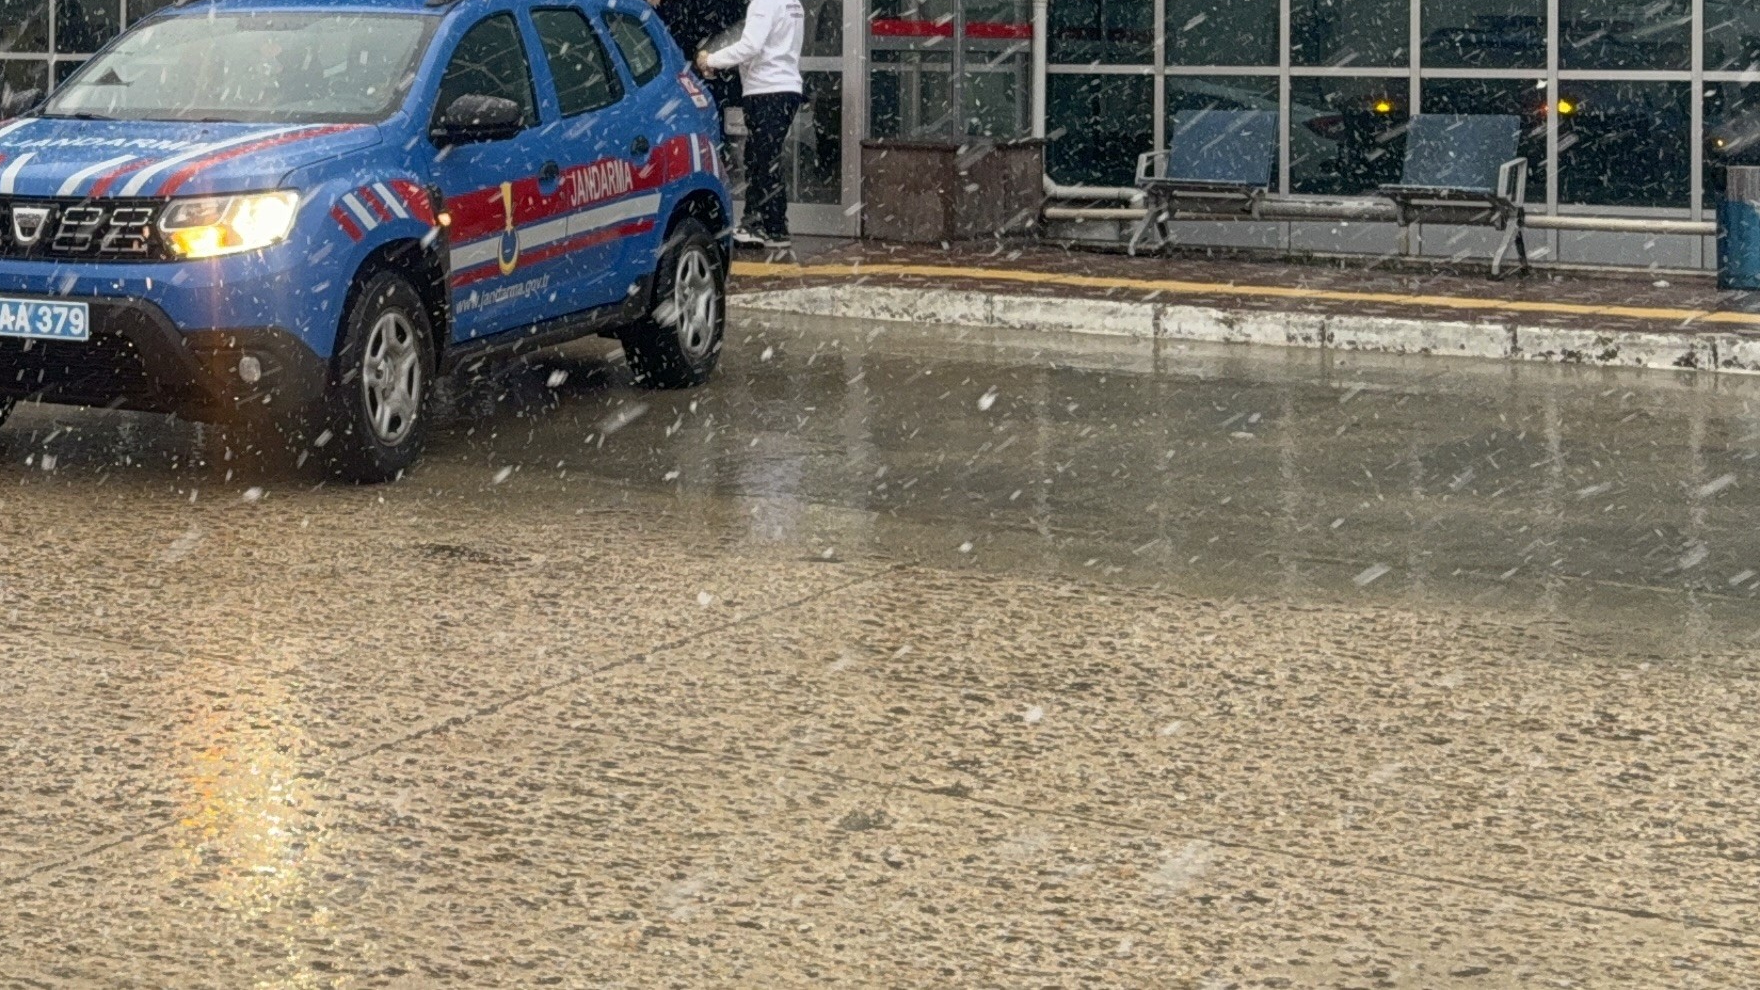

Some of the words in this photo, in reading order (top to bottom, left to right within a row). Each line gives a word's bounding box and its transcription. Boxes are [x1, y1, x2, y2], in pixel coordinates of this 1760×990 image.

[571, 159, 634, 207] JANDARMA
[456, 274, 550, 313] www.jandarma.gov.tr
[35, 306, 85, 335] 379
